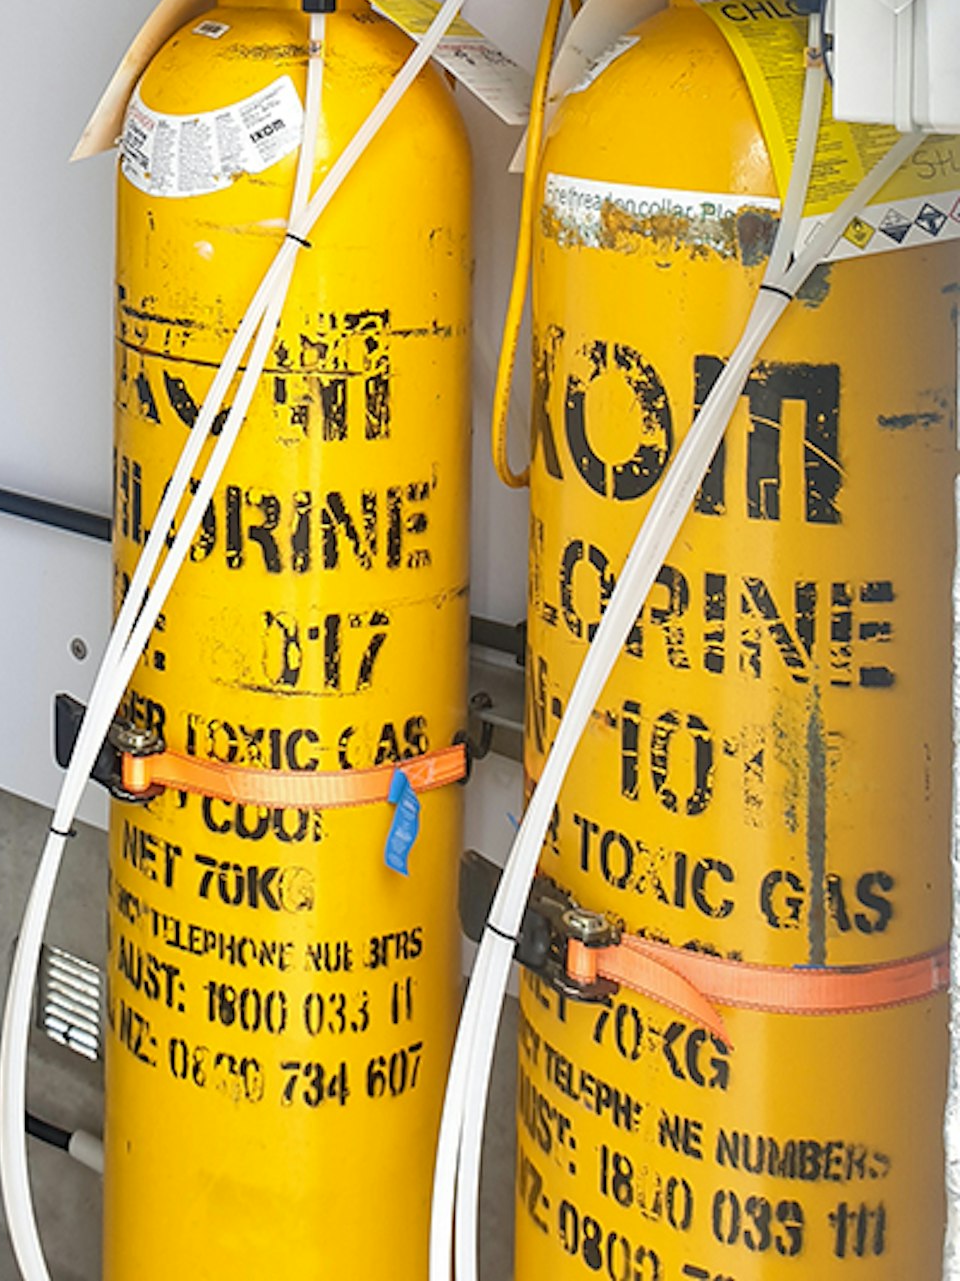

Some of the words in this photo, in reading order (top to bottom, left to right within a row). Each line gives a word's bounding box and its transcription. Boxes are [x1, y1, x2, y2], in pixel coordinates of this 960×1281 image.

[123, 819, 183, 888] NET
[760, 870, 896, 934] GAS
[203, 980, 287, 1035] 1800
[279, 1061, 351, 1108] 734
[366, 1041, 424, 1098] 607
